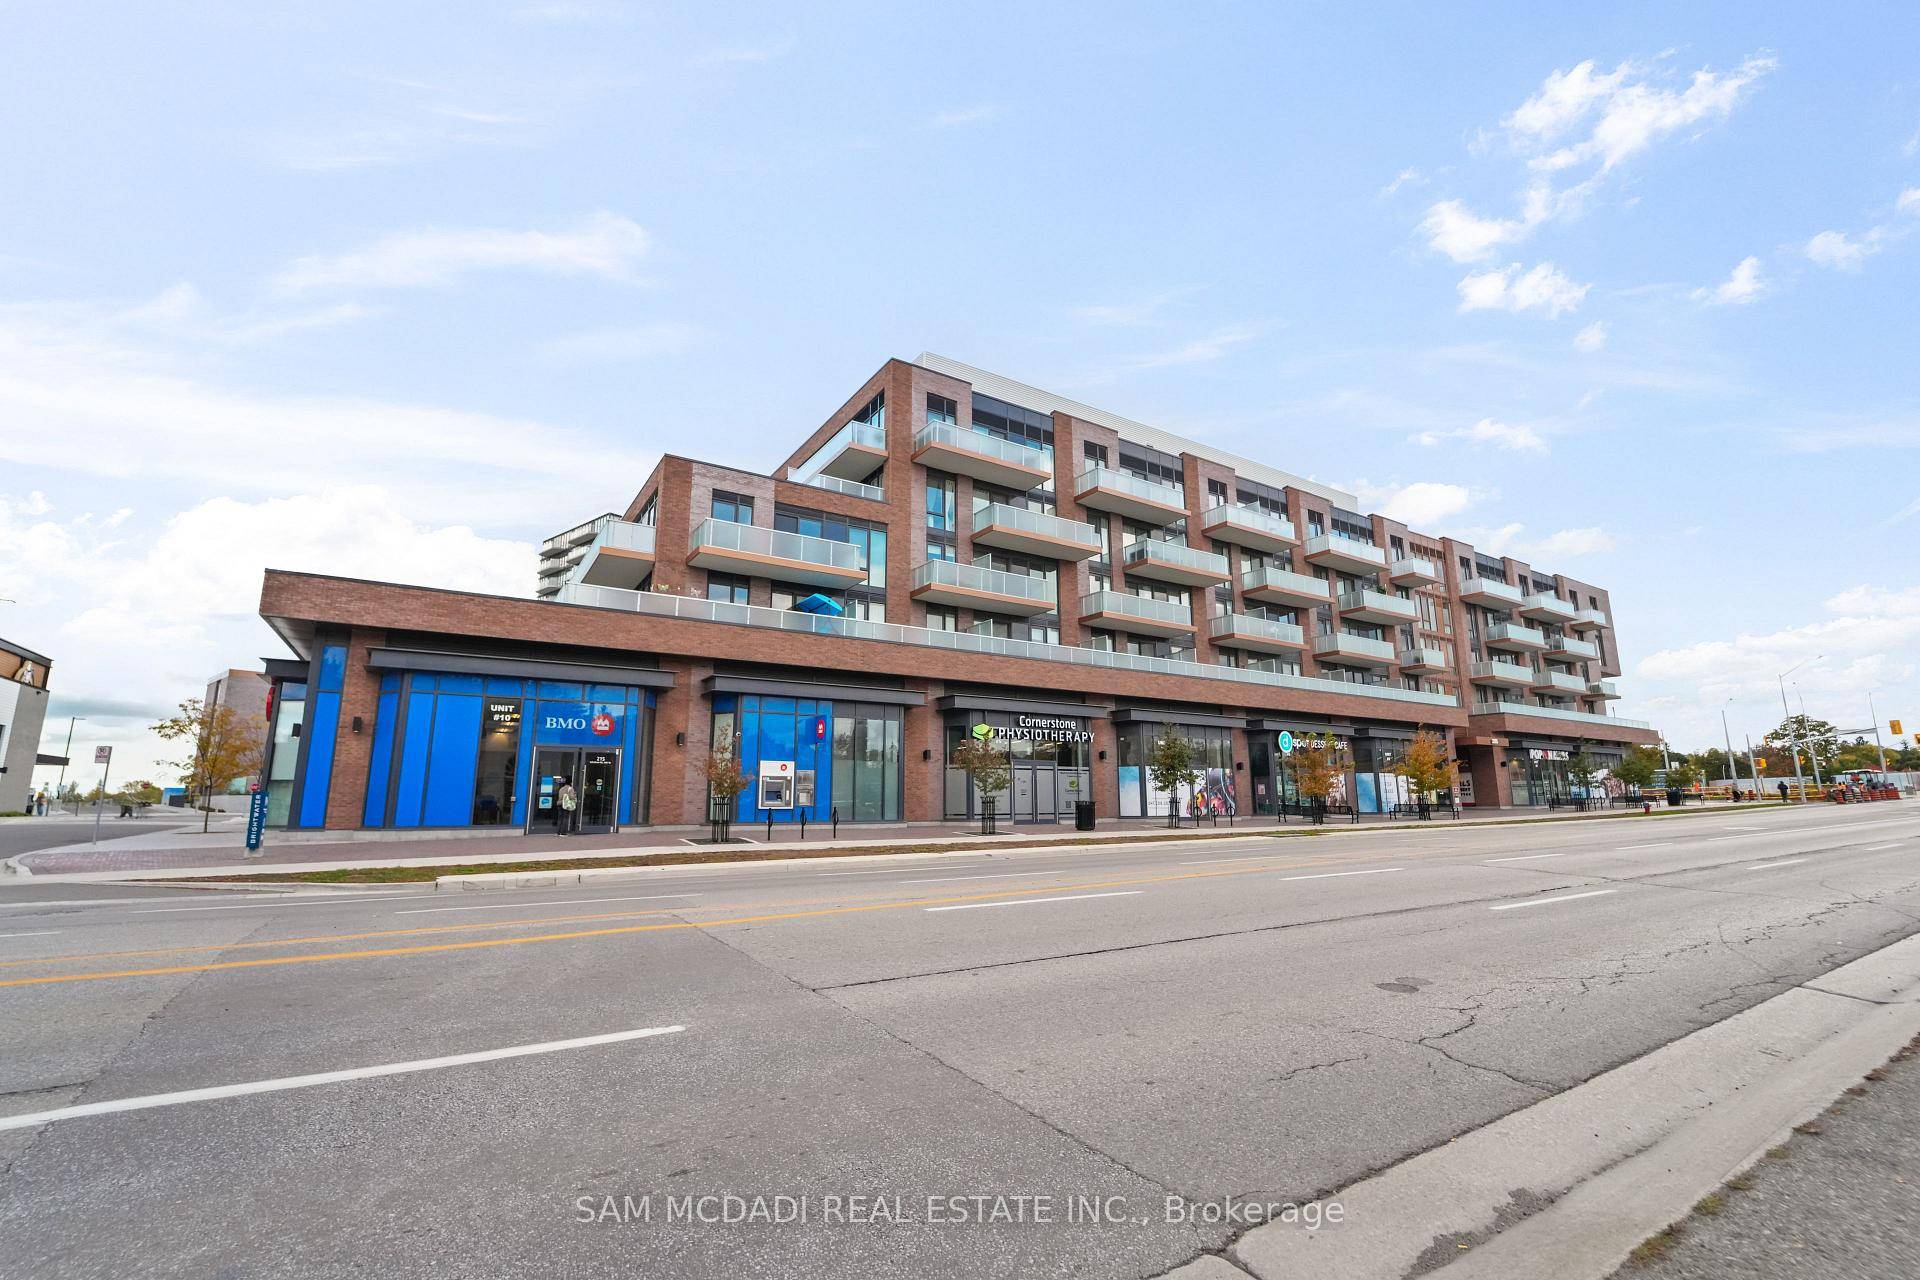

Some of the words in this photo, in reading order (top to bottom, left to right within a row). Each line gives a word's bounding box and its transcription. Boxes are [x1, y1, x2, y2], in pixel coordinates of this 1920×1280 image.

[490, 704, 515, 713] UNIT
[493, 713, 511, 722] #10
[545, 717, 586, 730] BMO
[1019, 715, 1076, 730] Cornerstone
[998, 727, 1095, 743] PHYSIOTHERAPY
[250, 794, 261, 844] BRIGHTWATER
